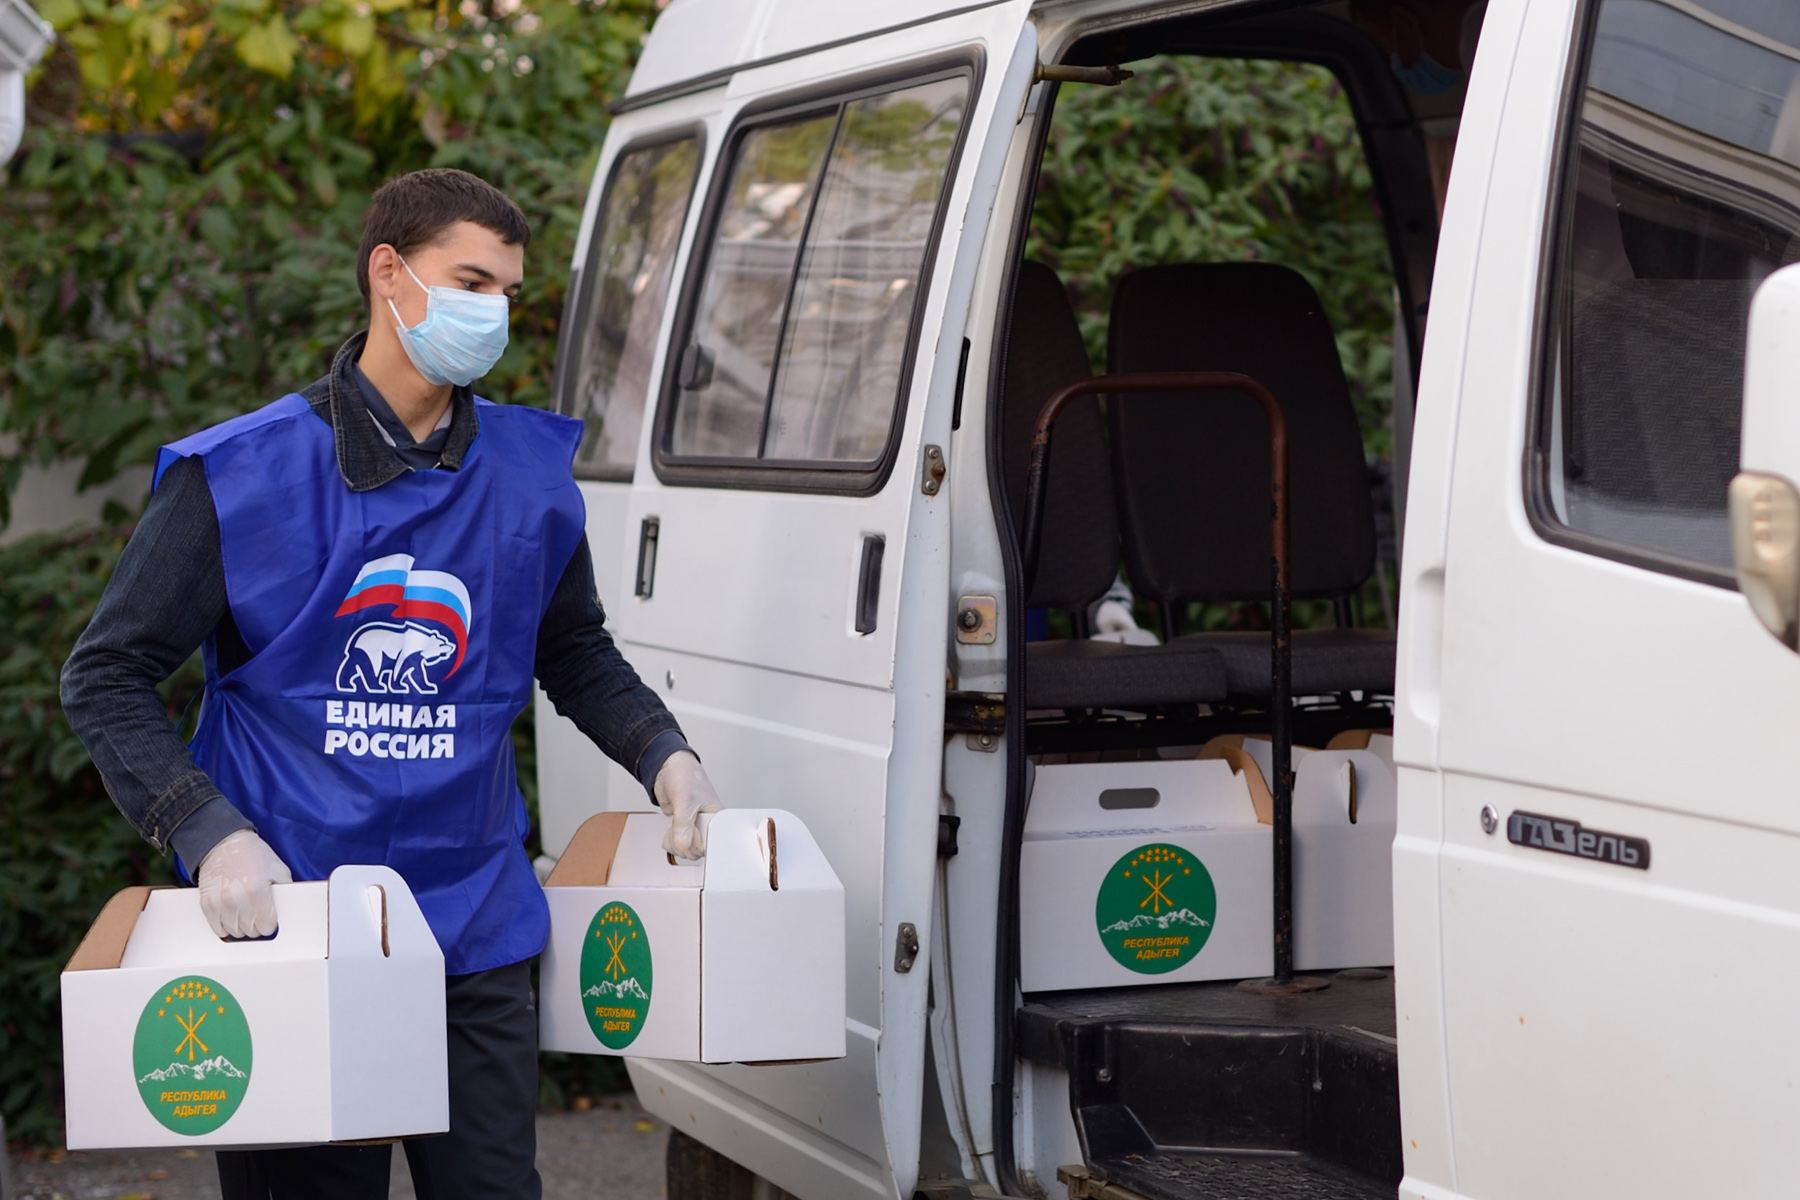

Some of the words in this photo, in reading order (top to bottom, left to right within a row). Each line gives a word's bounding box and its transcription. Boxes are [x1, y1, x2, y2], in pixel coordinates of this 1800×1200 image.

[326, 700, 456, 728] ЕДИНАЯ
[324, 730, 454, 759] РОССИЯ
[1123, 936, 1189, 948] РЕСПУБЛИКА
[1136, 948, 1180, 960] АДЫГЕЯ
[596, 1006, 636, 1018] РЕСПУБЛИКА
[603, 1020, 631, 1032] АДЫГЕЯ
[161, 1090, 226, 1102] РЕСПУБЛИКА
[173, 1104, 217, 1118] АДЫГЕЯ
